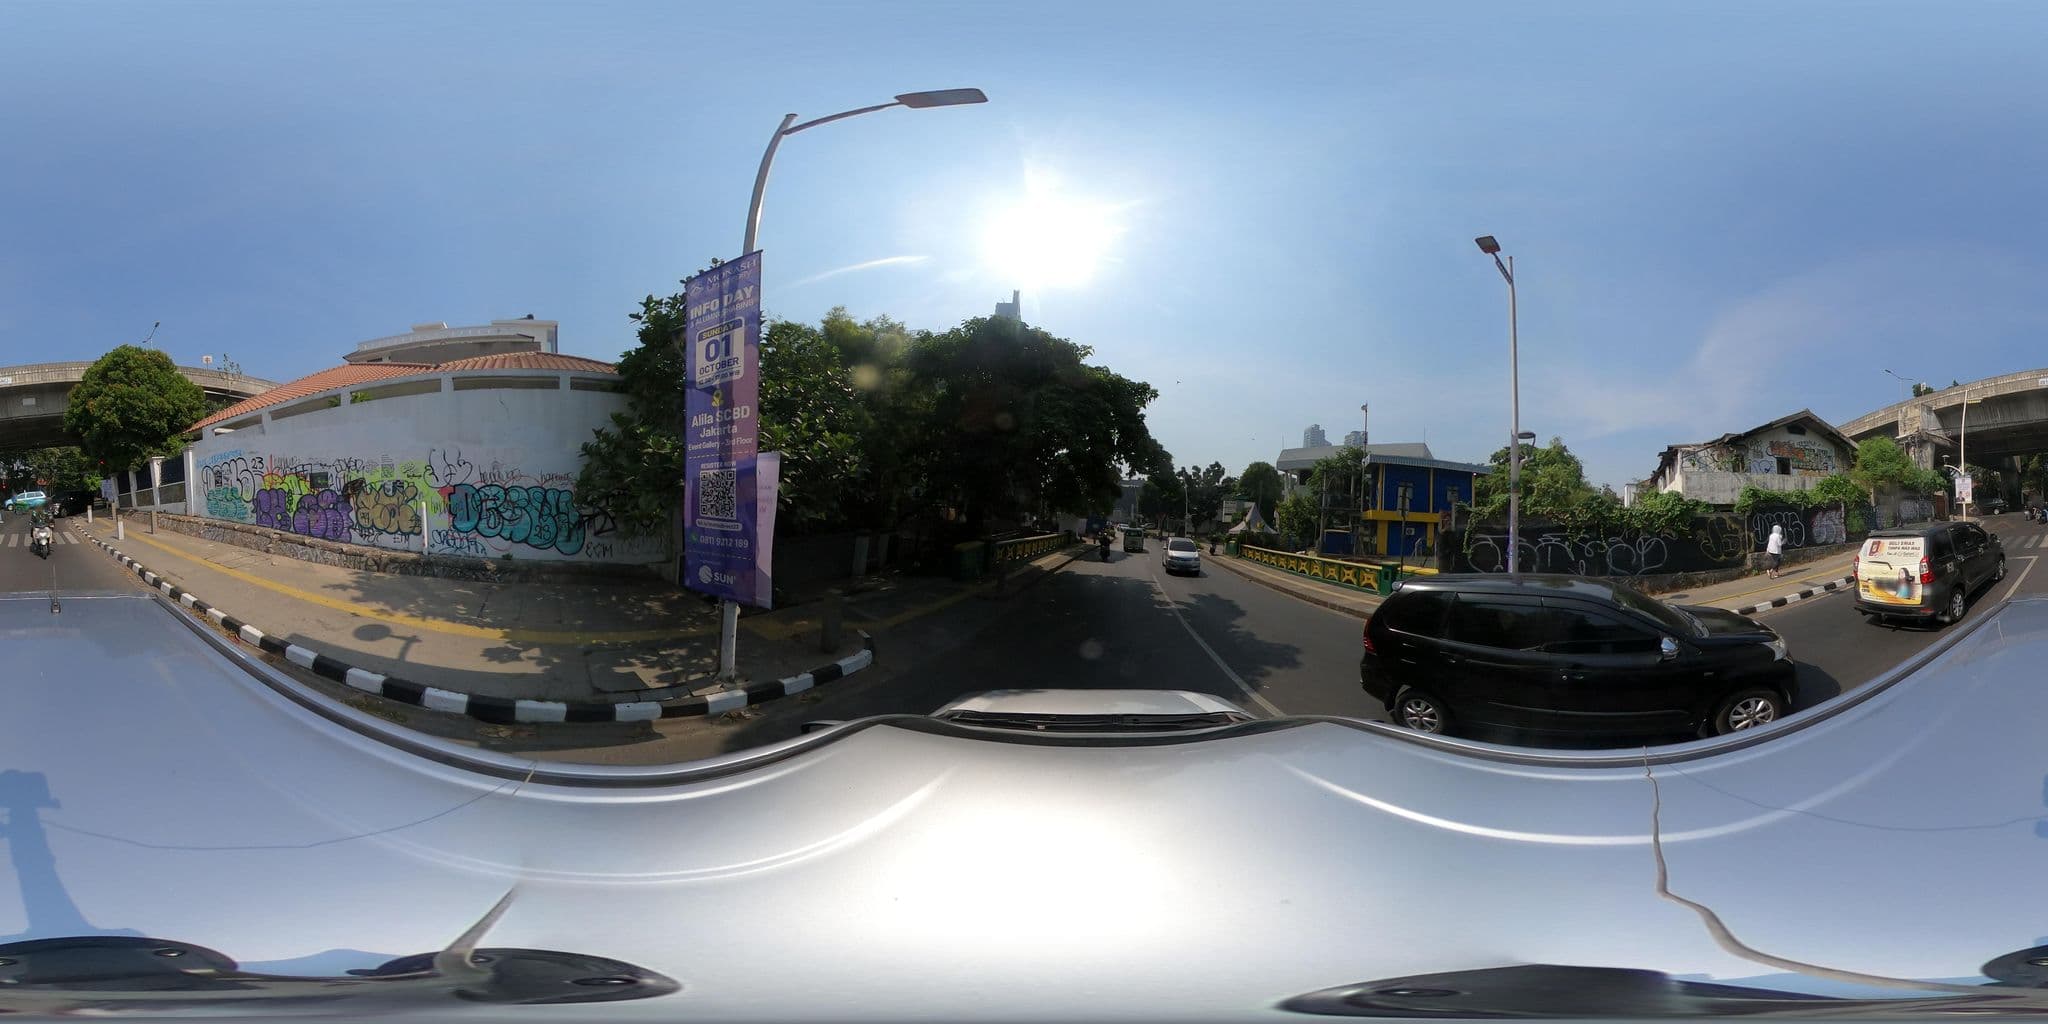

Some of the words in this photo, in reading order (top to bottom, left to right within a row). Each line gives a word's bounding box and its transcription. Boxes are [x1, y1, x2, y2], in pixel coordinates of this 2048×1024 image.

[690, 298, 720, 320] INFO
[723, 285, 755, 306] DAY
[702, 321, 734, 340] SUNDAY
[704, 334, 732, 362] 01
[699, 356, 740, 375] OCTOBER
[691, 413, 714, 428] Alila
[716, 405, 750, 422] SCBD
[700, 424, 738, 438] Jakarta
[688, 442, 702, 451] Event
[736, 437, 753, 446] Floor
[251, 456, 264, 470] 23
[714, 572, 734, 585] SUN
